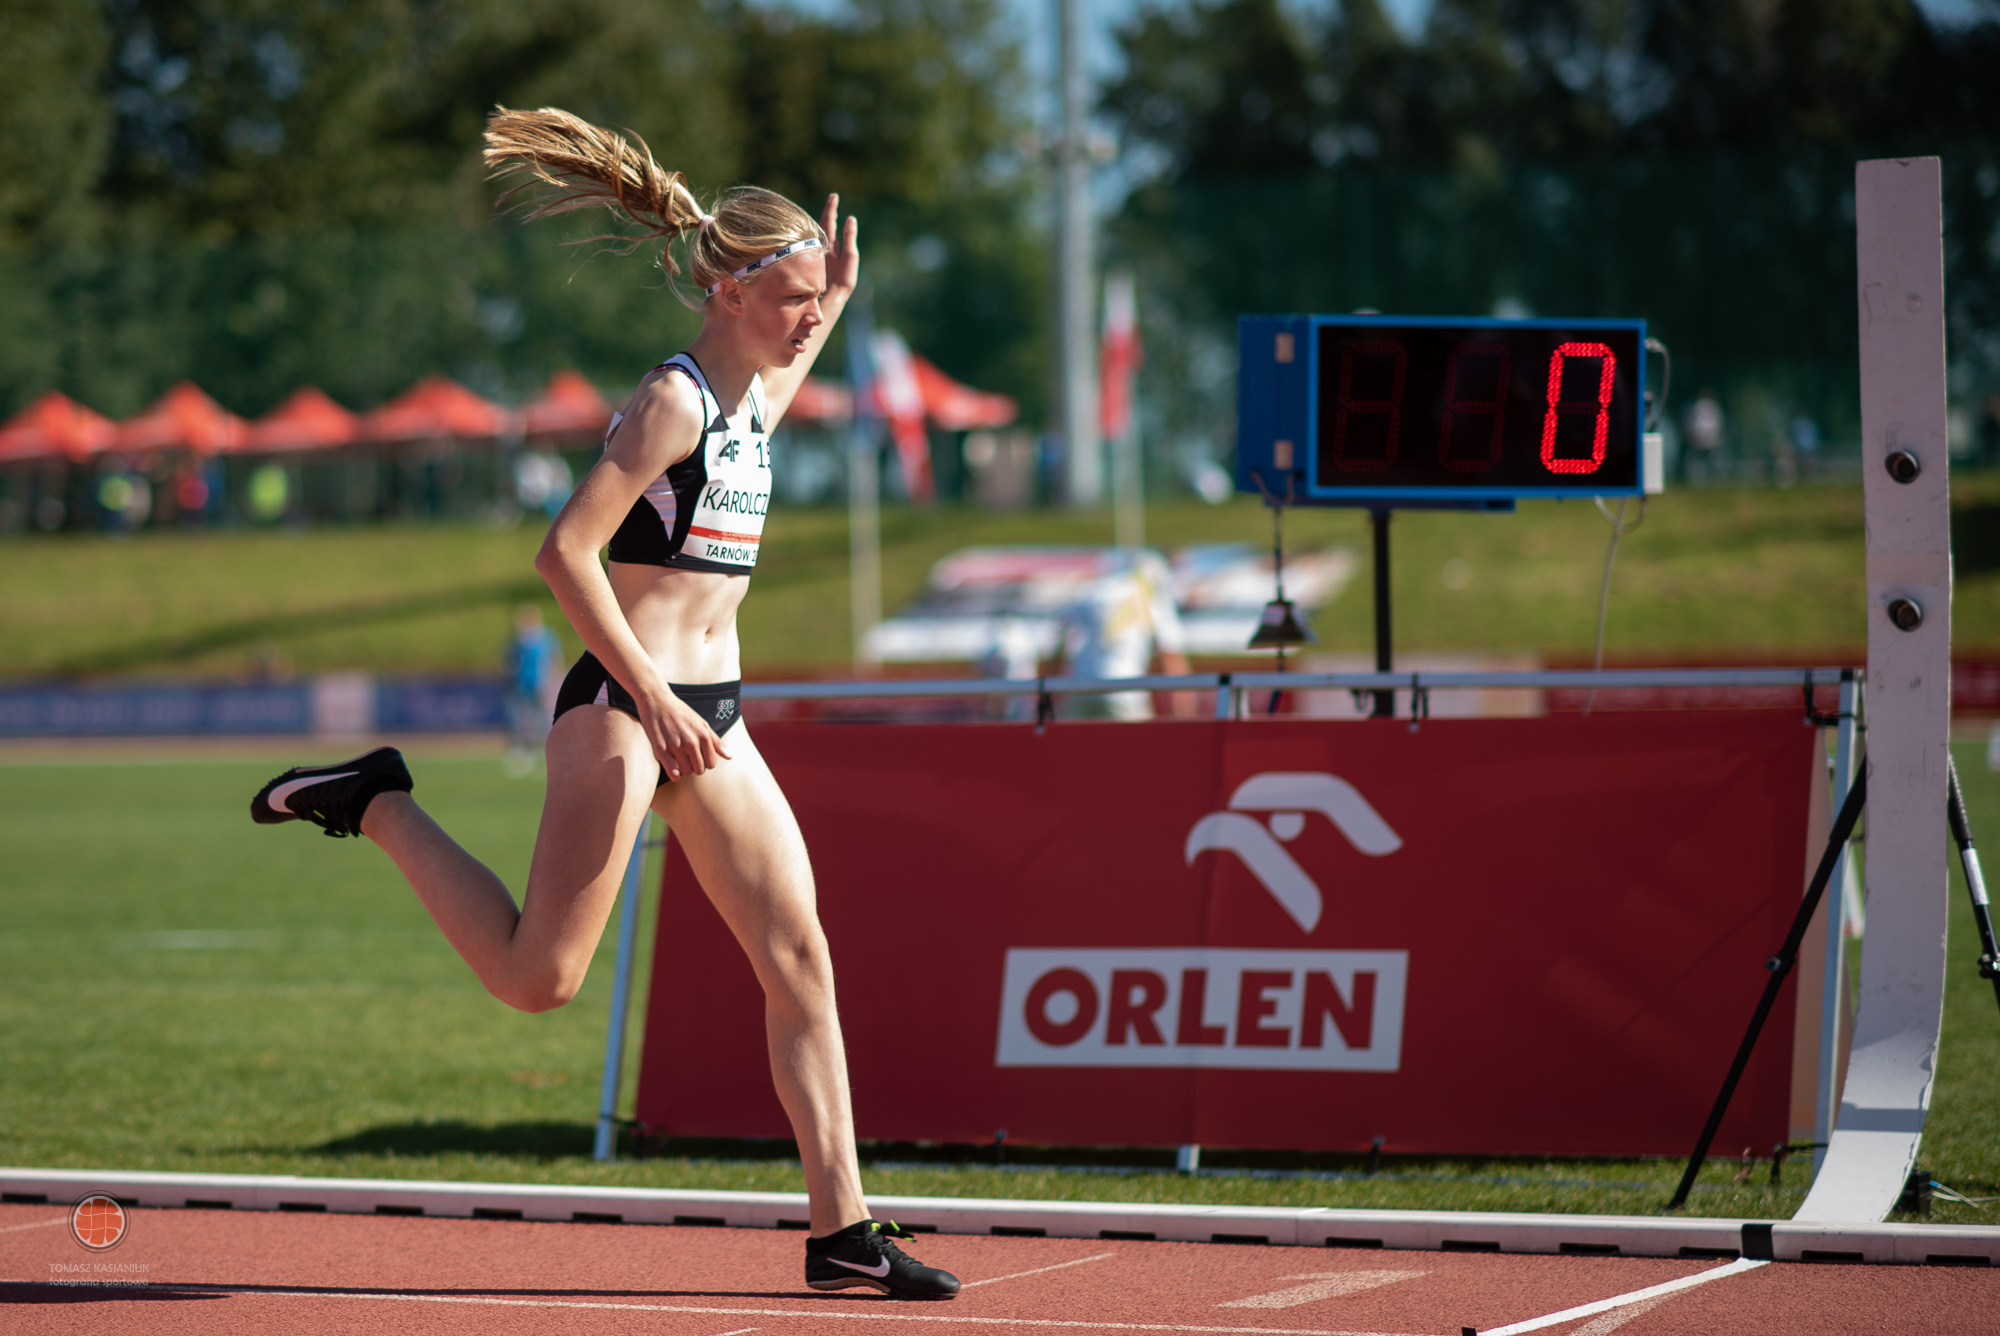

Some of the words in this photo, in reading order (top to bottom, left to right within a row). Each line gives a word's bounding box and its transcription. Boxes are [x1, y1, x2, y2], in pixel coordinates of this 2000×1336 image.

[775, 246, 792, 260] NIKE
[702, 486, 769, 516] KAROLCZ
[706, 543, 751, 562] TARNÓW
[1023, 966, 1379, 1051] ORLEN
